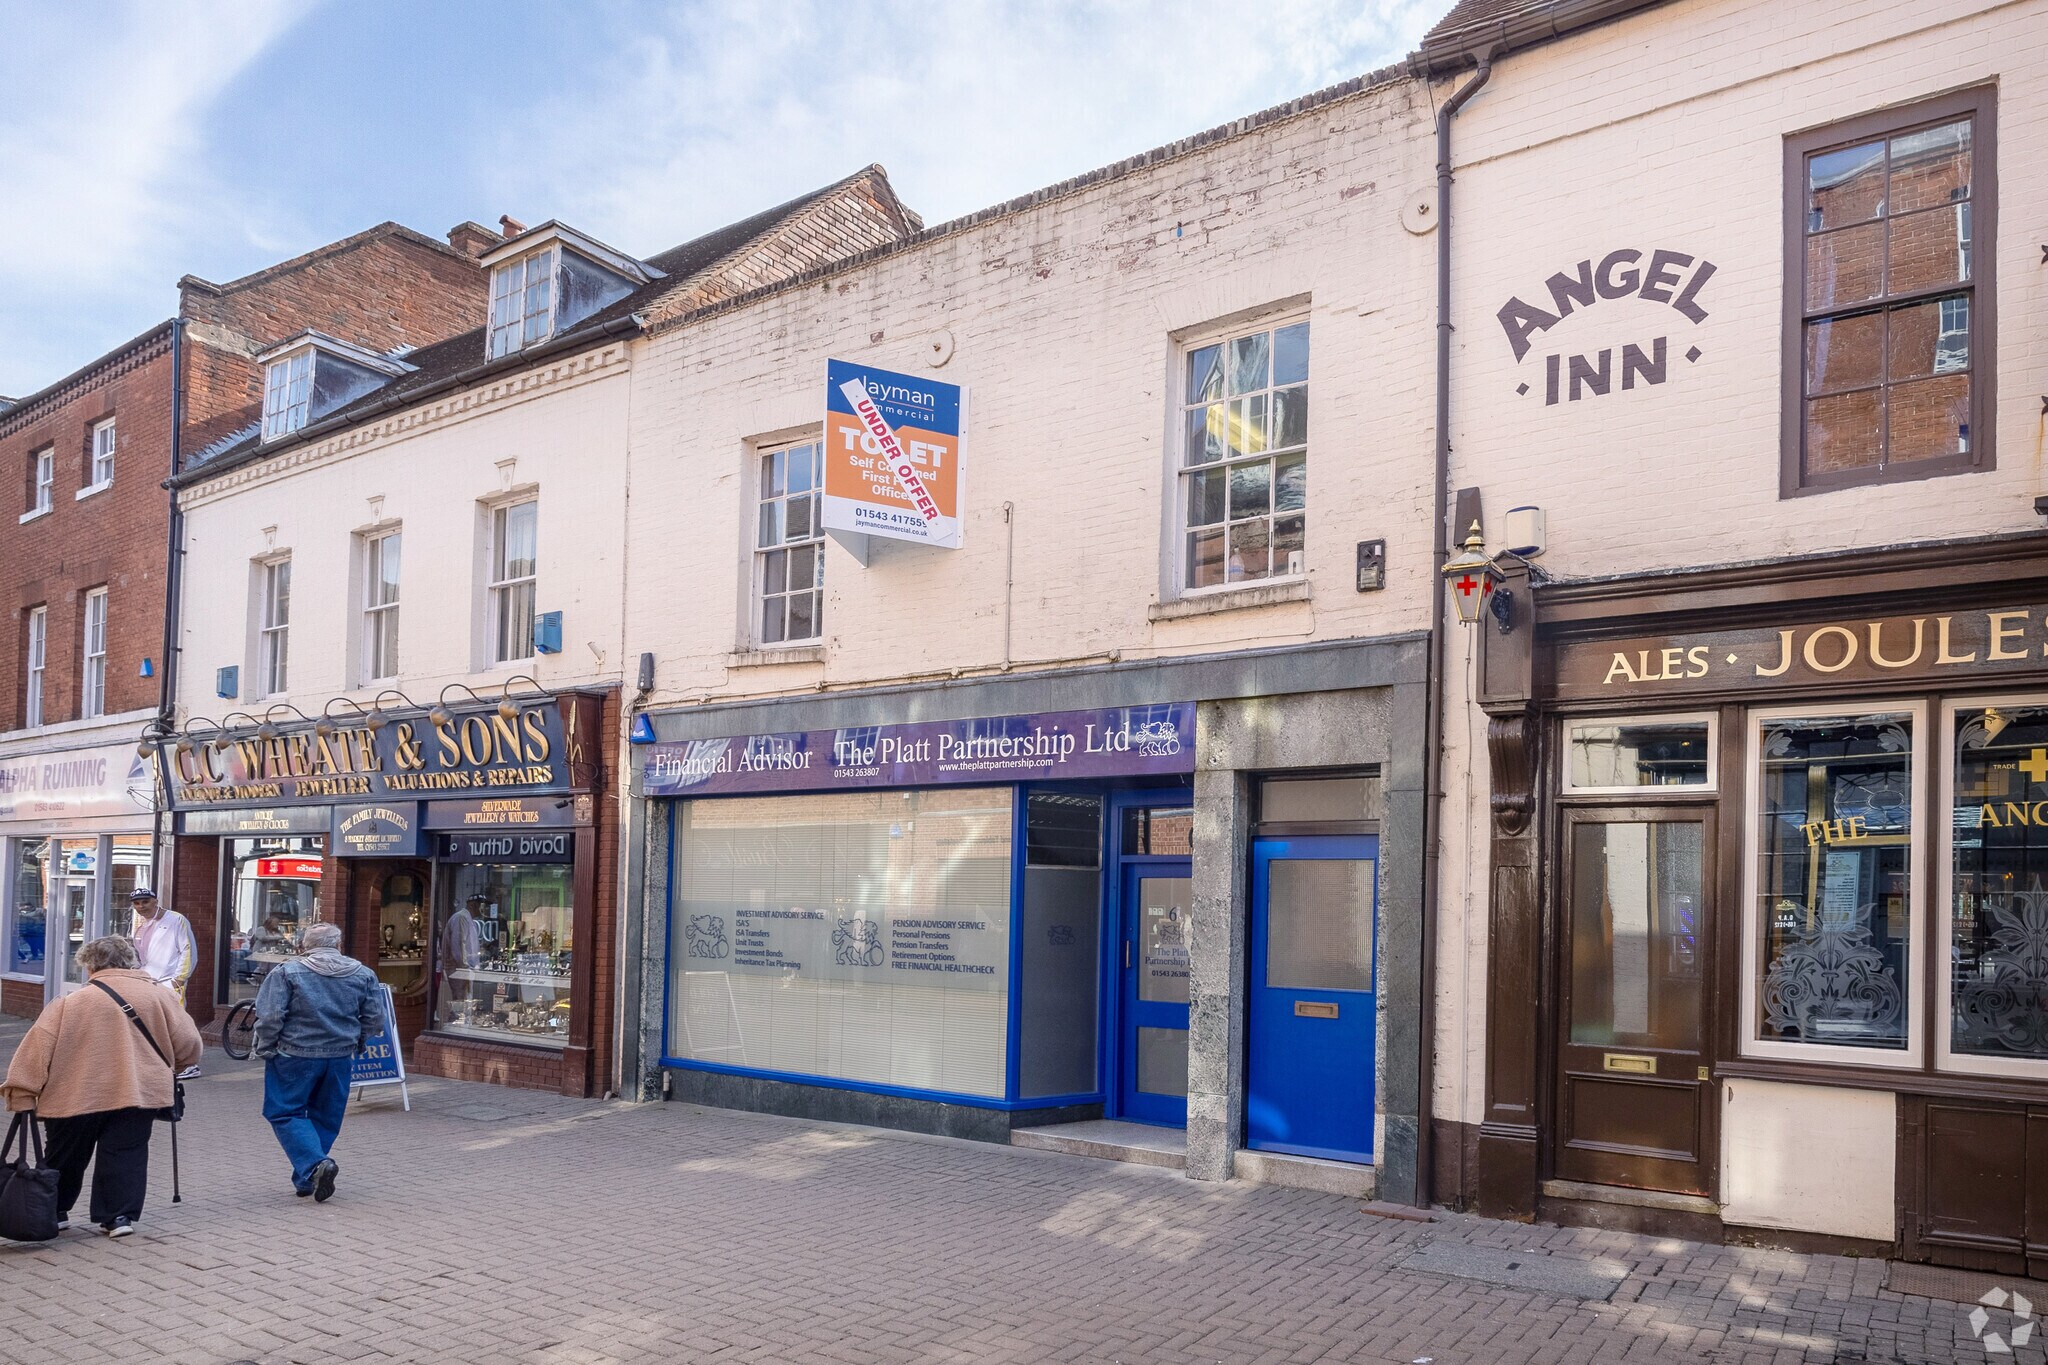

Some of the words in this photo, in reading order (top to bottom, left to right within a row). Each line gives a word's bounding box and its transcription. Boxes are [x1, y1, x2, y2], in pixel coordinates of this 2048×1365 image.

[1496, 248, 1718, 365] ANGEL
[1545, 336, 1667, 406] INN
[875, 404, 935, 422] mmercial
[857, 399, 901, 461] UNDER
[839, 426, 880, 455] TO
[896, 437, 947, 467] ET
[850, 455, 874, 469] Self
[862, 470, 890, 484] First
[872, 484, 910, 501] Office
[898, 464, 938, 521] OFFER
[855, 507, 888, 521] 01543
[855, 519, 929, 537] jaymancommercial.co.uk
[1603, 646, 1709, 685] ALES
[1755, 610, 2048, 677] JOULE
[234, 729, 383, 780] WHEATE
[395, 723, 426, 771] &
[436, 709, 550, 768] SONS
[654, 749, 732, 777] Financial
[737, 745, 813, 772] Advisor
[836, 740, 874, 767] The
[880, 735, 931, 764] Platt
[937, 725, 1076, 763] Partnership
[1084, 721, 1131, 754] Ltd
[939, 758, 1053, 772] www.theplattpartnership.com
[43, 757, 107, 790] RUNNING
[834, 769, 854, 778] 01543
[855, 767, 880, 777] 263807
[296, 777, 371, 797] JEWELLER
[384, 770, 470, 790] VALUATIONS
[473, 770, 486, 787] &
[488, 765, 553, 786] REPAIRS
[481, 800, 522, 812] SILVERWARE
[340, 817, 353, 834] THE
[352, 808, 373, 826] FAMILY
[373, 808, 409, 831] JEWELLERS
[463, 812, 498, 824] JEWELLERY
[499, 811, 507, 823] &
[508, 811, 539, 823] WATCHES
[1799, 815, 1868, 847] THE
[736, 910, 771, 918] INVESTMENT
[771, 911, 800, 919] ADVISORY
[800, 912, 824, 920] SERVICE
[1169, 906, 1177, 921] 6
[892, 919, 921, 928] PENSION
[922, 920, 957, 929] ADVISORY
[958, 921, 986, 930] SERVICE
[745, 929, 770, 938] Transfers
[892, 930, 920, 939] Personal
[921, 930, 950, 940] Pensions
[747, 939, 764, 947] Trusts
[892, 940, 917, 949] Pension
[918, 941, 949, 950] Transfers
[735, 948, 765, 957] Investment
[766, 948, 783, 957] Bonds
[891, 951, 928, 960] Retirement
[928, 952, 955, 962] Options
[1156, 948, 1170, 956] The
[735, 957, 765, 967] Inheritance
[765, 959, 775, 967] Tax
[776, 959, 801, 970] Planning
[891, 961, 907, 970] FREE
[908, 962, 944, 971] FINANCIAL
[944, 963, 995, 974] HEALTHCHECK
[1145, 956, 1186, 968] Partnership
[357, 1062, 382, 1071] ITEM
